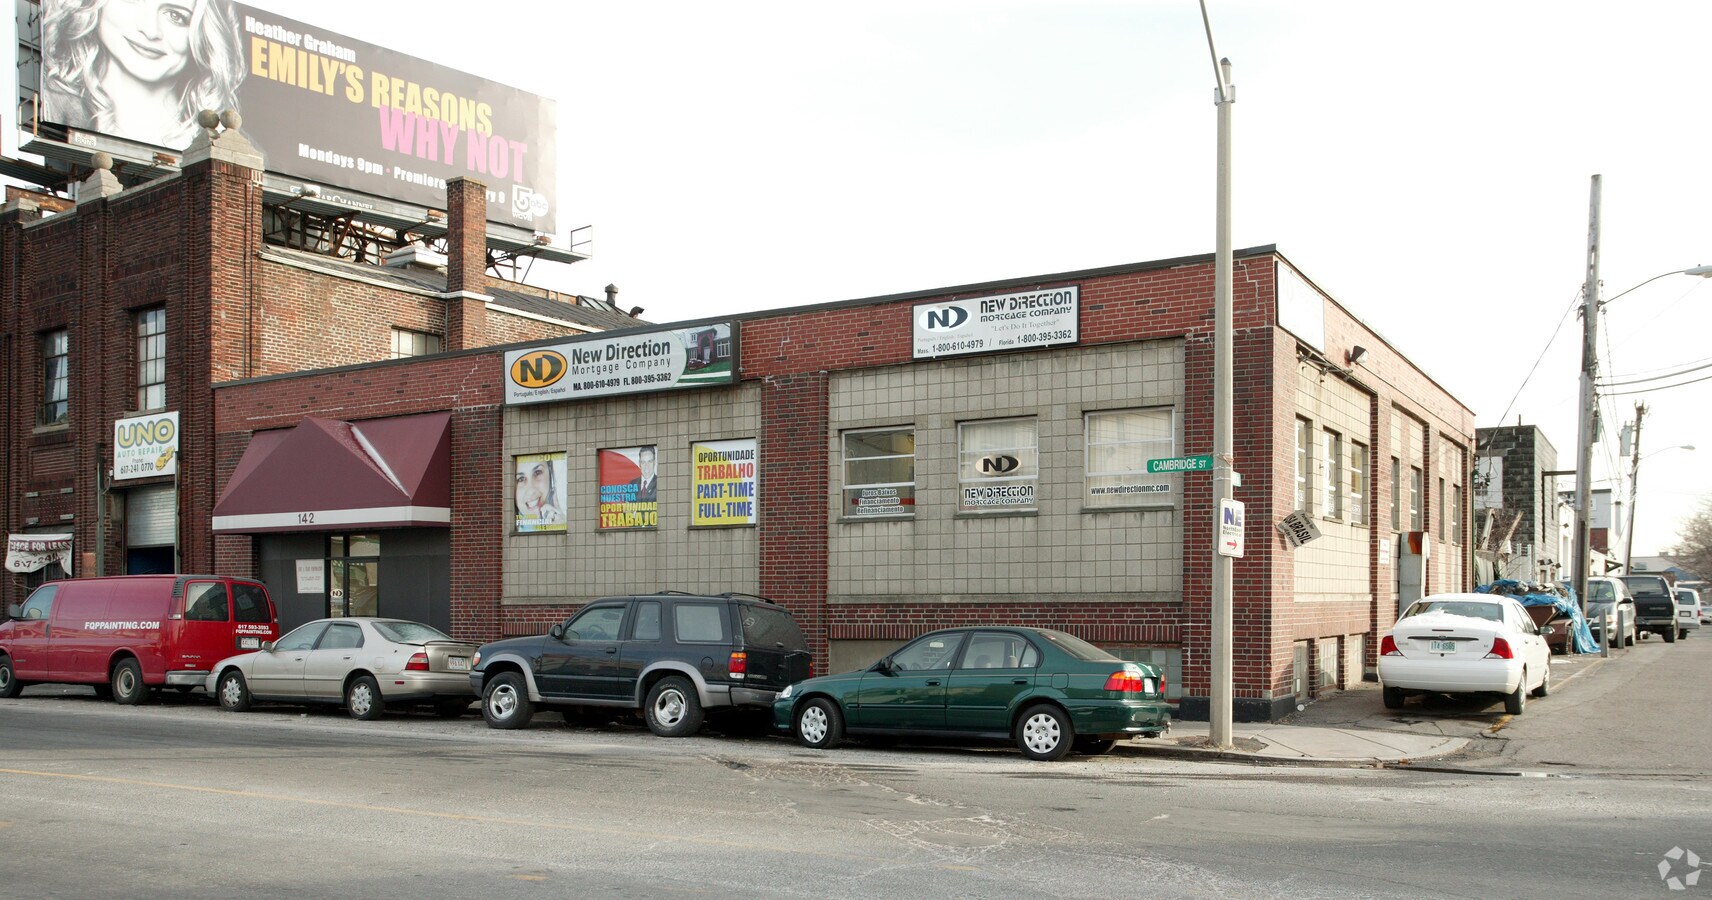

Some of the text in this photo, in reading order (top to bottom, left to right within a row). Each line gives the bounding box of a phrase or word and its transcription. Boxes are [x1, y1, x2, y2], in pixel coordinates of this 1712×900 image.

[245, 15, 356, 63] Heather Graham
[251, 36, 493, 138] EMILY'S REASONS
[379, 104, 527, 183] WHY NOT
[298, 143, 448, 190] Mondays 9pm Premiere
[514, 186, 531, 213] 5
[980, 306, 1072, 322] MORTGAGE COMPANY
[981, 299, 1006, 313] NEW
[928, 306, 968, 329] ND
[932, 339, 984, 352] 1-800-610-4979
[998, 338, 1014, 346] Florida
[1017, 329, 1072, 344] 1-800-395-3362
[572, 339, 670, 364] New Direction
[520, 354, 563, 383] ND
[572, 358, 671, 375] Mortgage Company
[583, 378, 620, 390] 800-610-4979
[631, 372, 672, 385] 800-395-3362
[118, 418, 175, 449] UNO
[117, 446, 164, 458] AUTO REPAIR
[698, 449, 755, 462] OPORTUNIDADE
[120, 462, 154, 474] 617-241 0770
[697, 462, 754, 480] TRABALHO
[983, 455, 1019, 472] ND
[1153, 459, 1207, 471] CAMBRIDGE ST
[600, 483, 639, 494] CONOSCA
[697, 482, 754, 499] PART-TIME
[964, 488, 984, 499] NEW
[1091, 484, 1170, 495] www.newdirectionmc.com
[600, 492, 637, 503] NUESTRA
[1001, 497, 1034, 505] COMPANY
[298, 513, 314, 524] 142
[699, 502, 753, 518] FULL-TIME
[600, 511, 658, 528] TRABAJO
[1289, 521, 1312, 544] BRASIL
[32, 541, 46, 551] FOR
[84, 621, 159, 630] FQPPAINTING.COM
